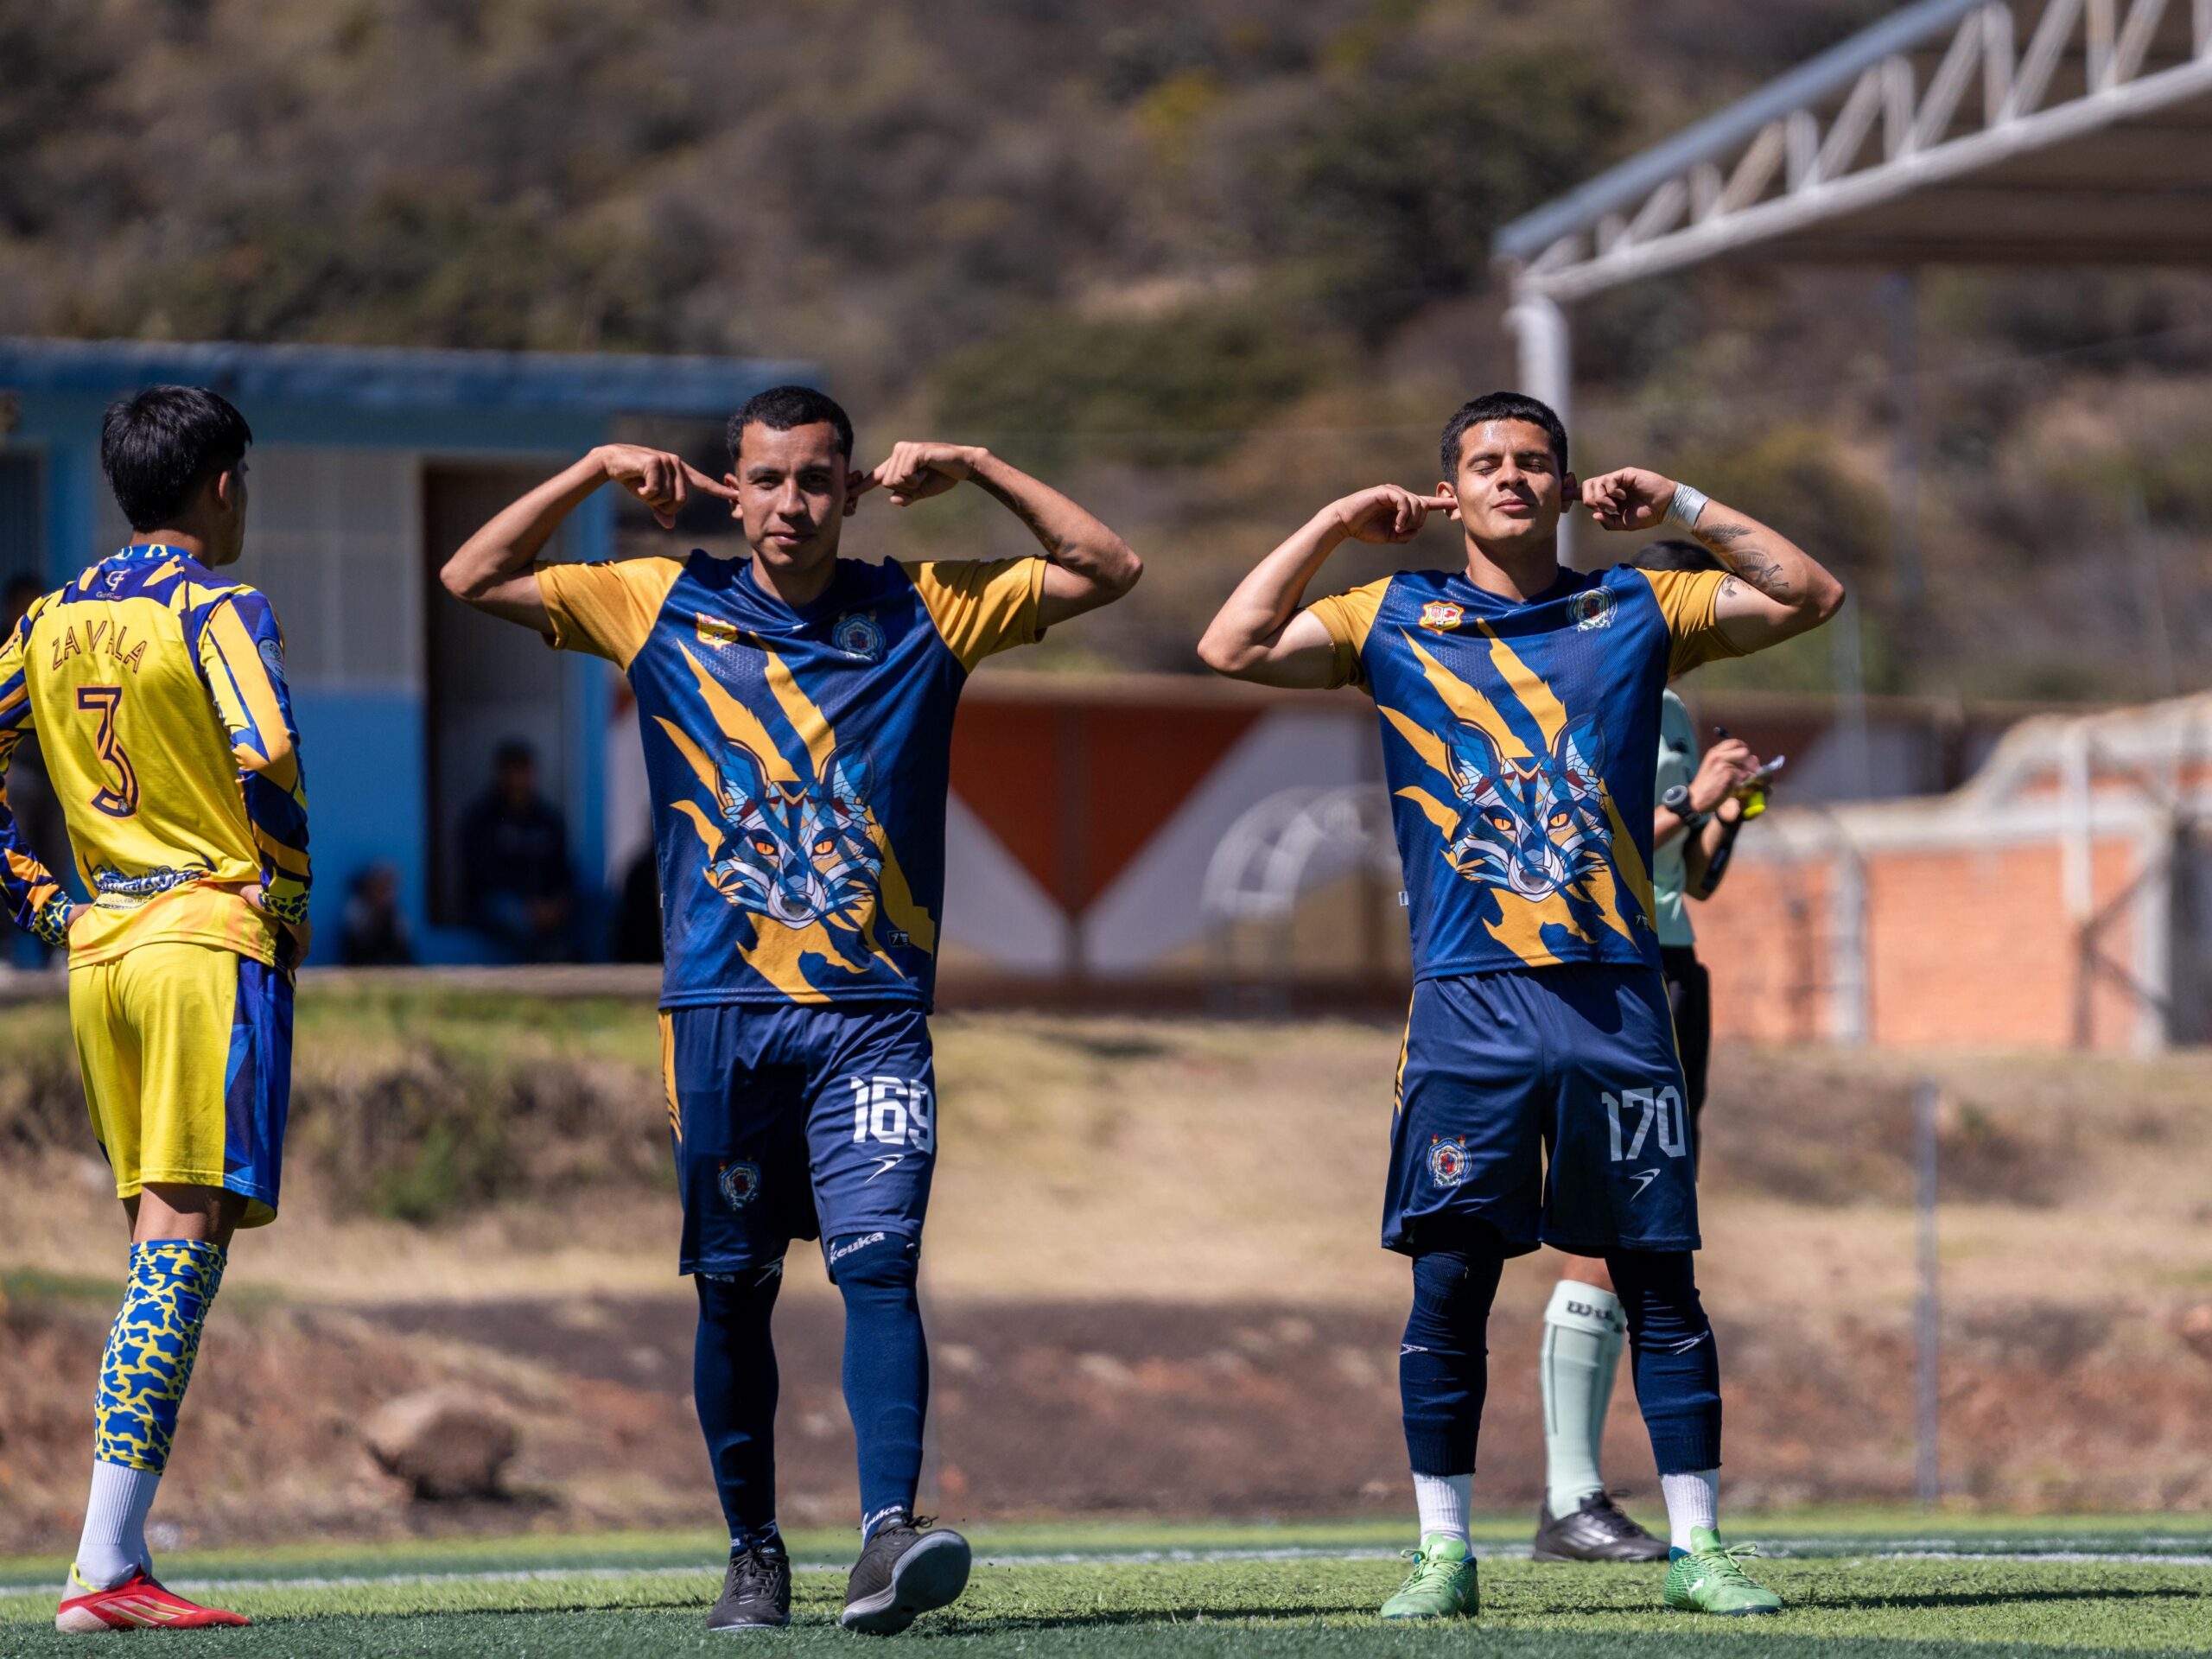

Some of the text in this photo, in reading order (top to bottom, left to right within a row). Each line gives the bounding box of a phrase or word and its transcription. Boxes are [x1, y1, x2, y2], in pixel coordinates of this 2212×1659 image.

[52, 619, 148, 675] ZAVALA
[75, 684, 139, 819] 3
[850, 1076, 934, 1155] 169
[1601, 1084, 1687, 1162] 170
